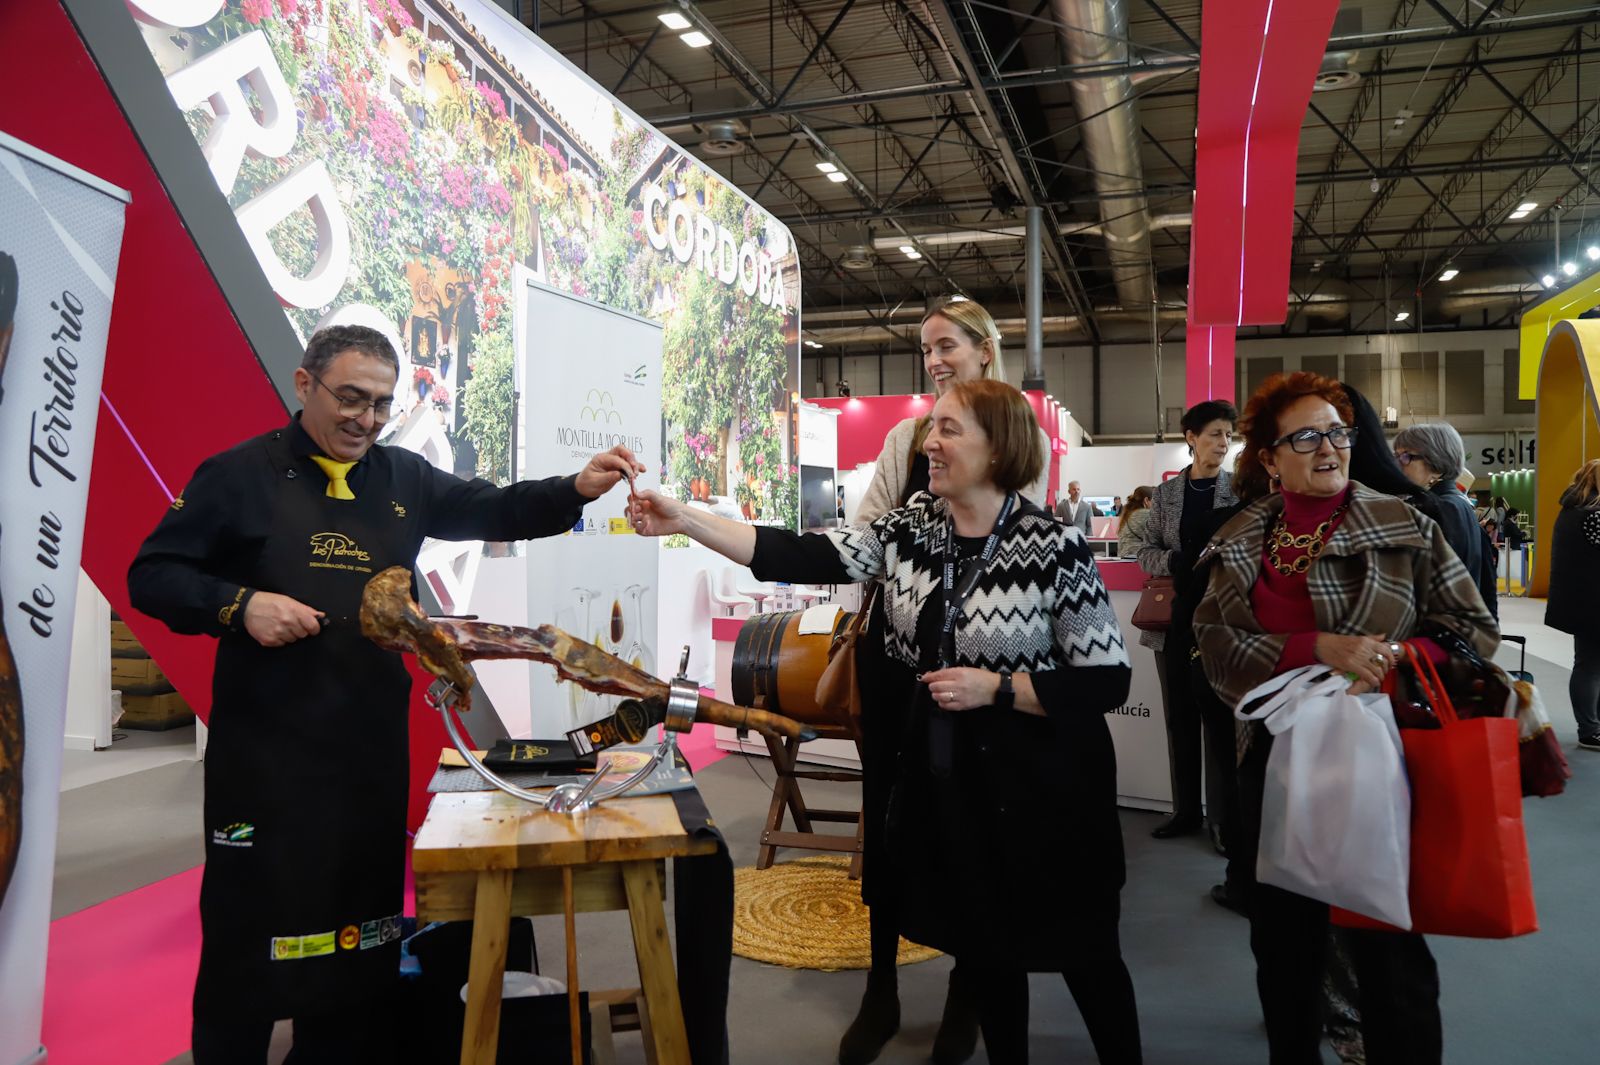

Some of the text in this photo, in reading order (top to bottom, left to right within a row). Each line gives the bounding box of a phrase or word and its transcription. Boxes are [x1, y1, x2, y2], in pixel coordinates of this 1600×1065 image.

[18, 290, 84, 638] de un Territorio
[557, 427, 604, 450] MONTILLA
